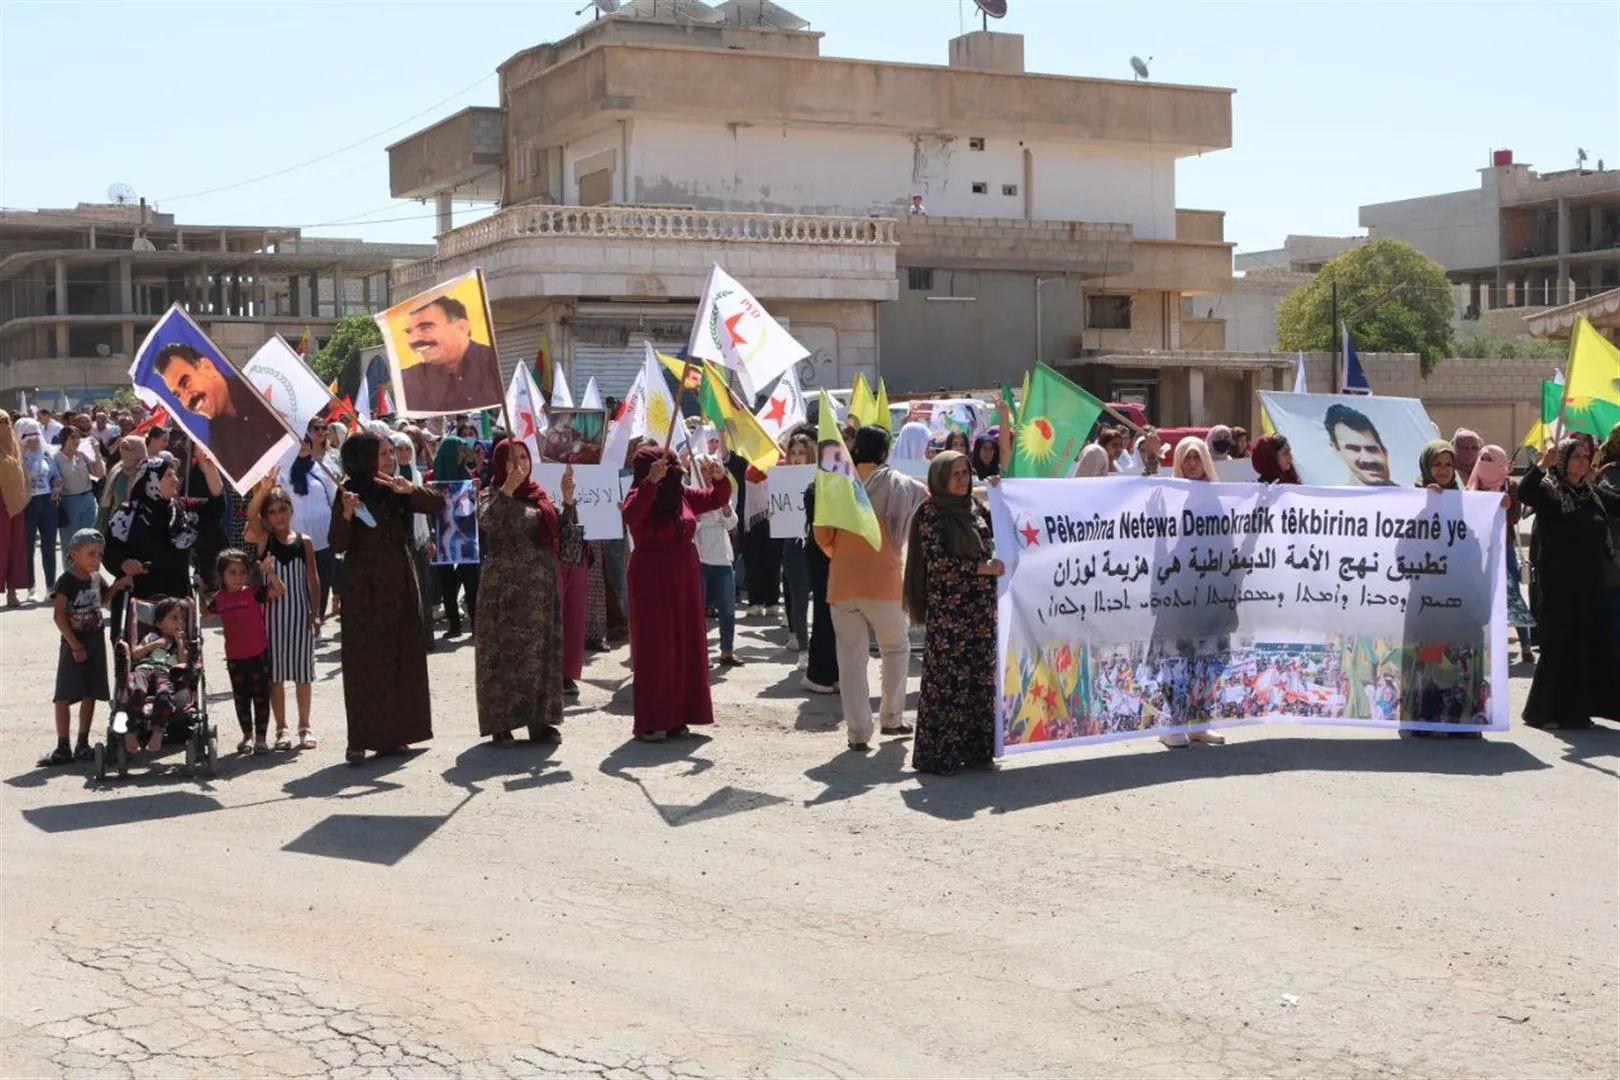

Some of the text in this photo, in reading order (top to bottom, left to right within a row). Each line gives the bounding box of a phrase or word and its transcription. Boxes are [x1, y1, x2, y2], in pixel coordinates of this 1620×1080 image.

[770, 492, 793, 512] NA
[1044, 507, 1467, 546] Pêkanîna Netewa Demokratîk têkbirina lozanê ye
[1053, 544, 1448, 586] تطبيق نهج الأمة الديمقراطية هي هزيمة لوزان
